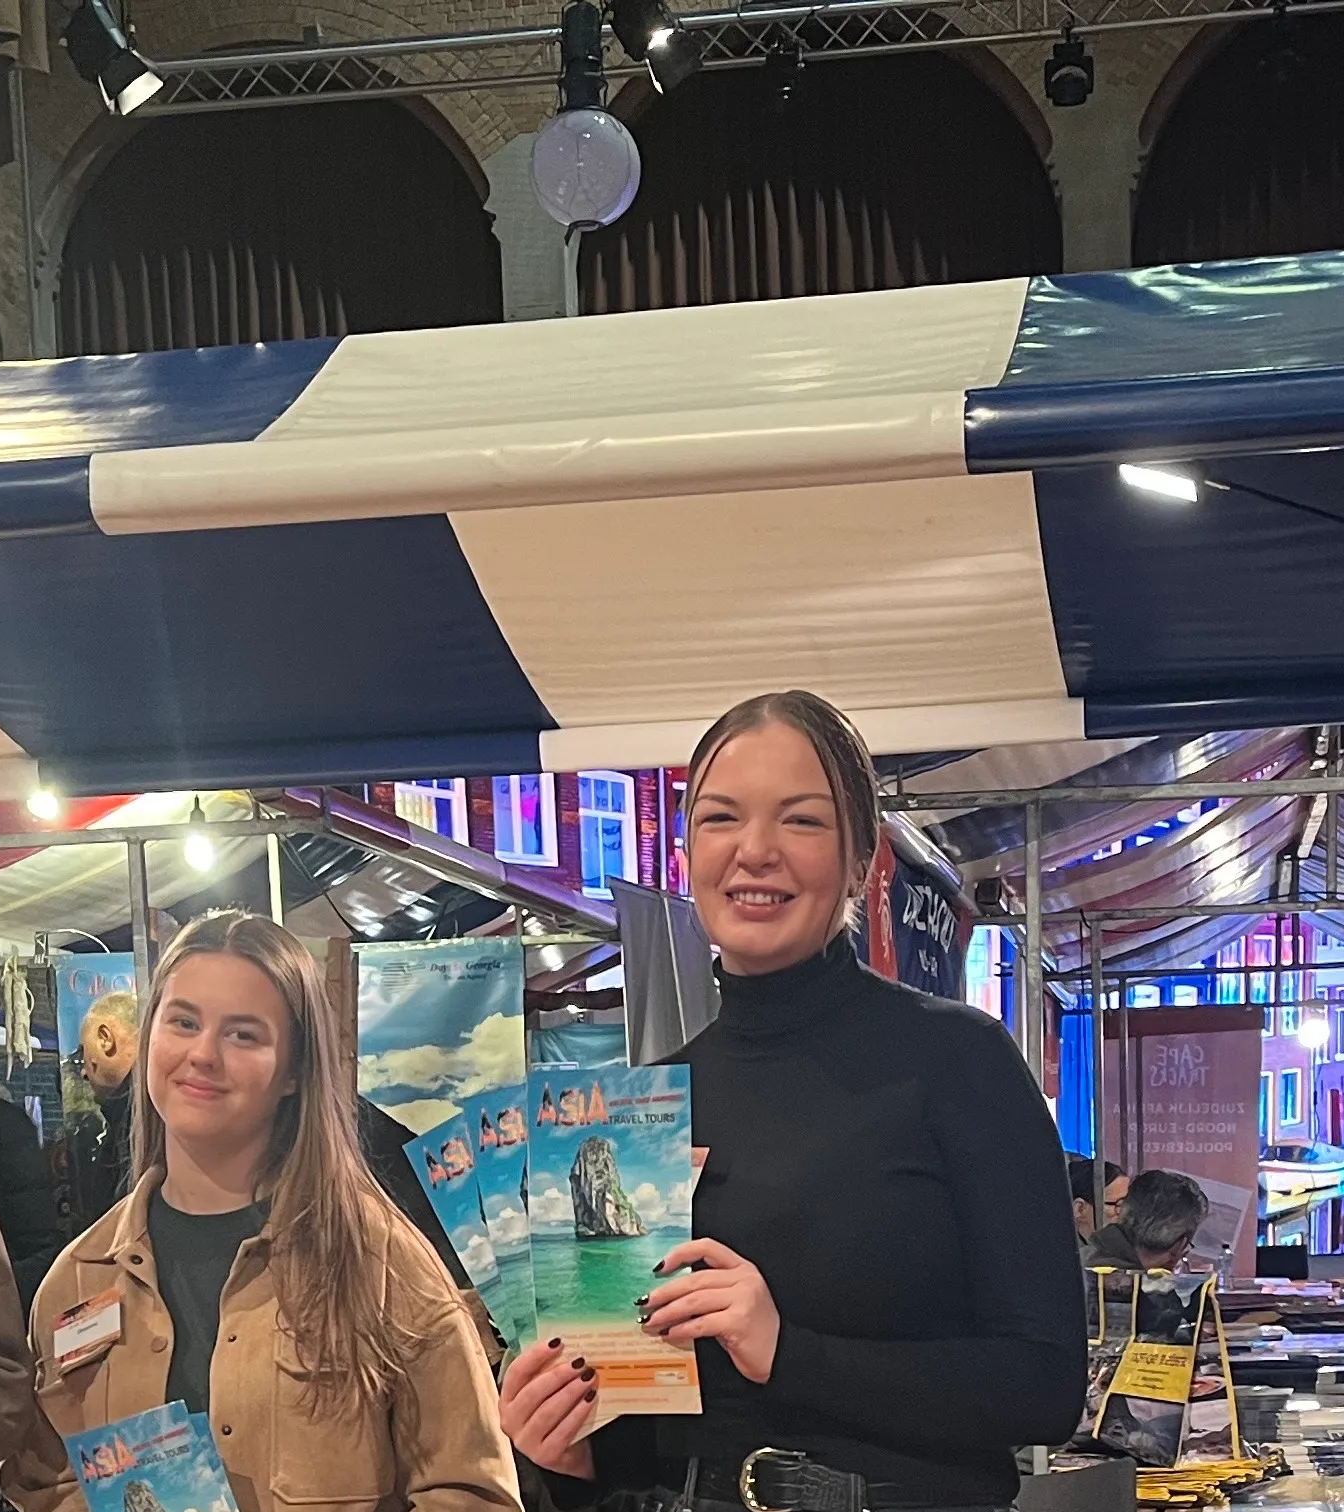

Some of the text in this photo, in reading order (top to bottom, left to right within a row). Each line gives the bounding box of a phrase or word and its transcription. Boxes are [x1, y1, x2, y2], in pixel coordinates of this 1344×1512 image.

[536, 1080, 608, 1127] ASIA
[608, 1112, 676, 1125] TRAVEL TOURS
[480, 1106, 528, 1152] ASI
[423, 1137, 474, 1190] ASI
[78, 1432, 136, 1483] ASIA
